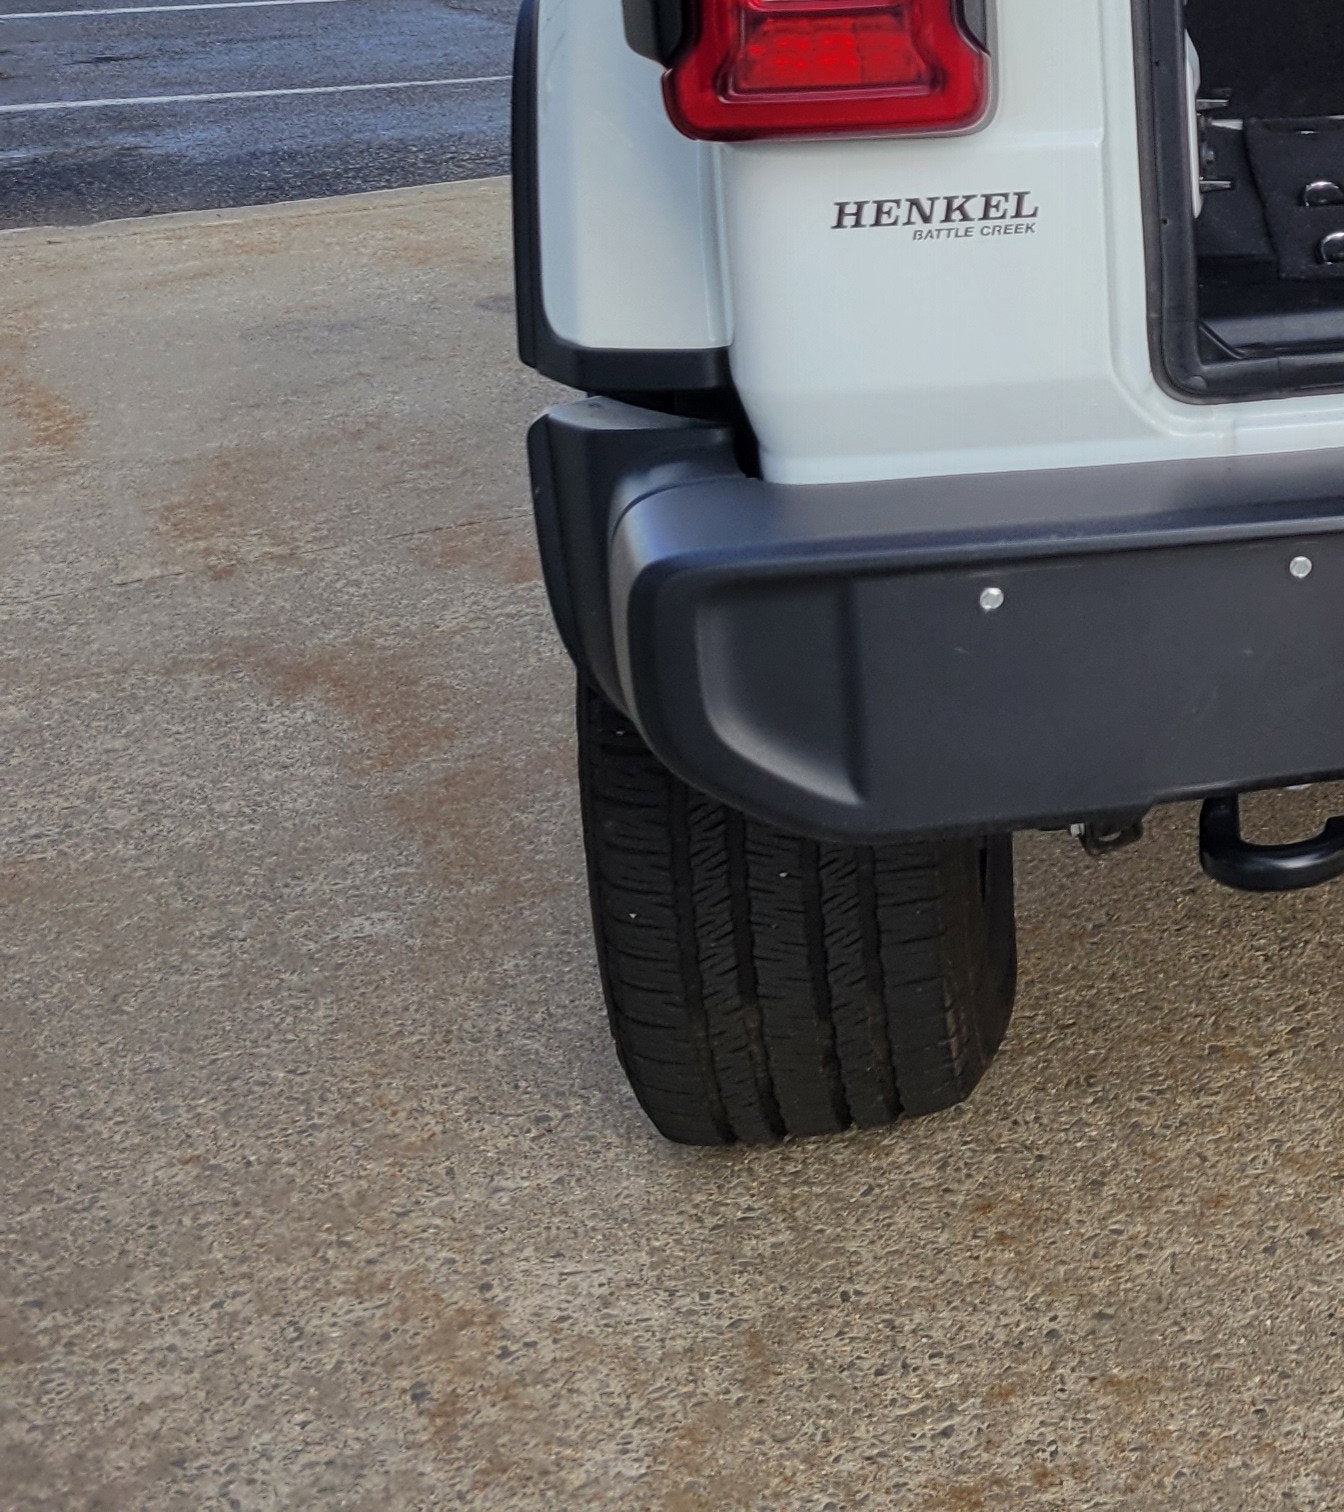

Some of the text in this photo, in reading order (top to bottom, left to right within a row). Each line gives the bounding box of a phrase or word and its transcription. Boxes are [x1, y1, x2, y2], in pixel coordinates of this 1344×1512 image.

[830, 190, 1040, 230] HENKEL
[912, 222, 1037, 241] BATTLE CREEK
